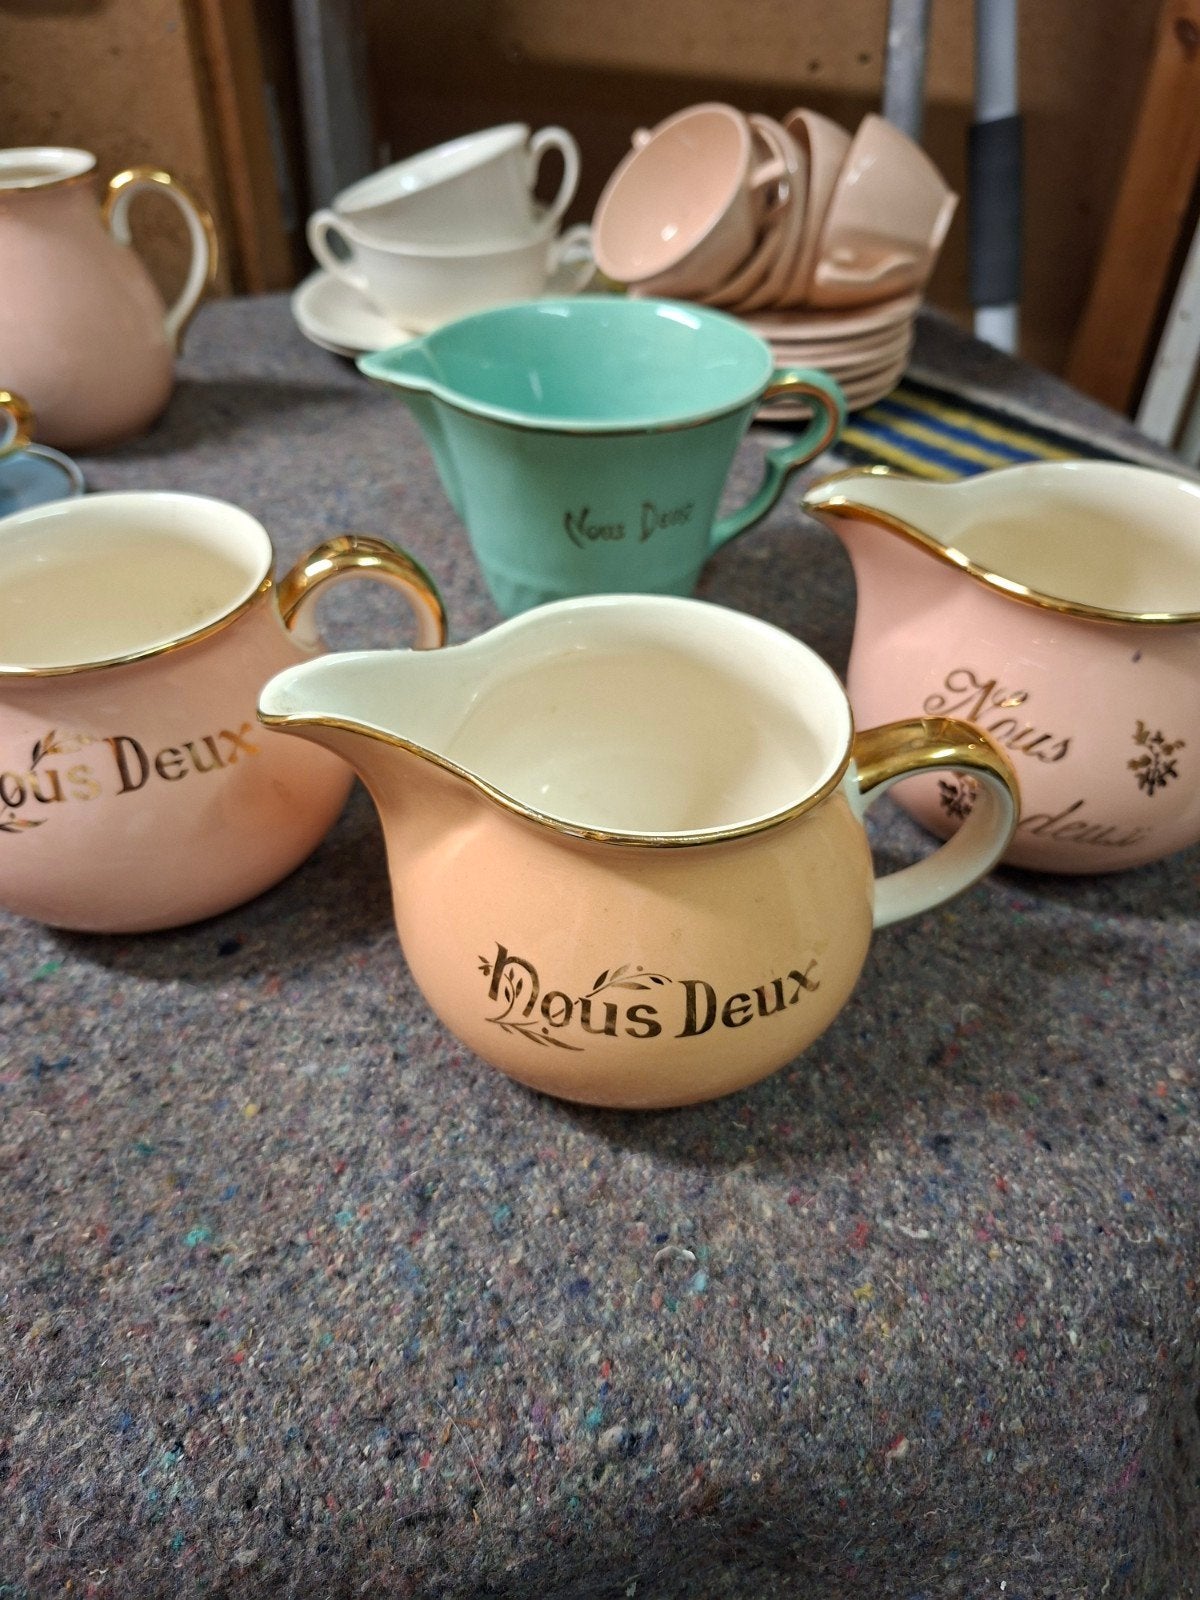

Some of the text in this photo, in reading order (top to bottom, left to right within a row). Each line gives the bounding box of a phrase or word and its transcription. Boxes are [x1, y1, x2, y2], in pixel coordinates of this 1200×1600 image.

[0, 722, 260, 808] ous Deux
[675, 959, 821, 1038] Deux
